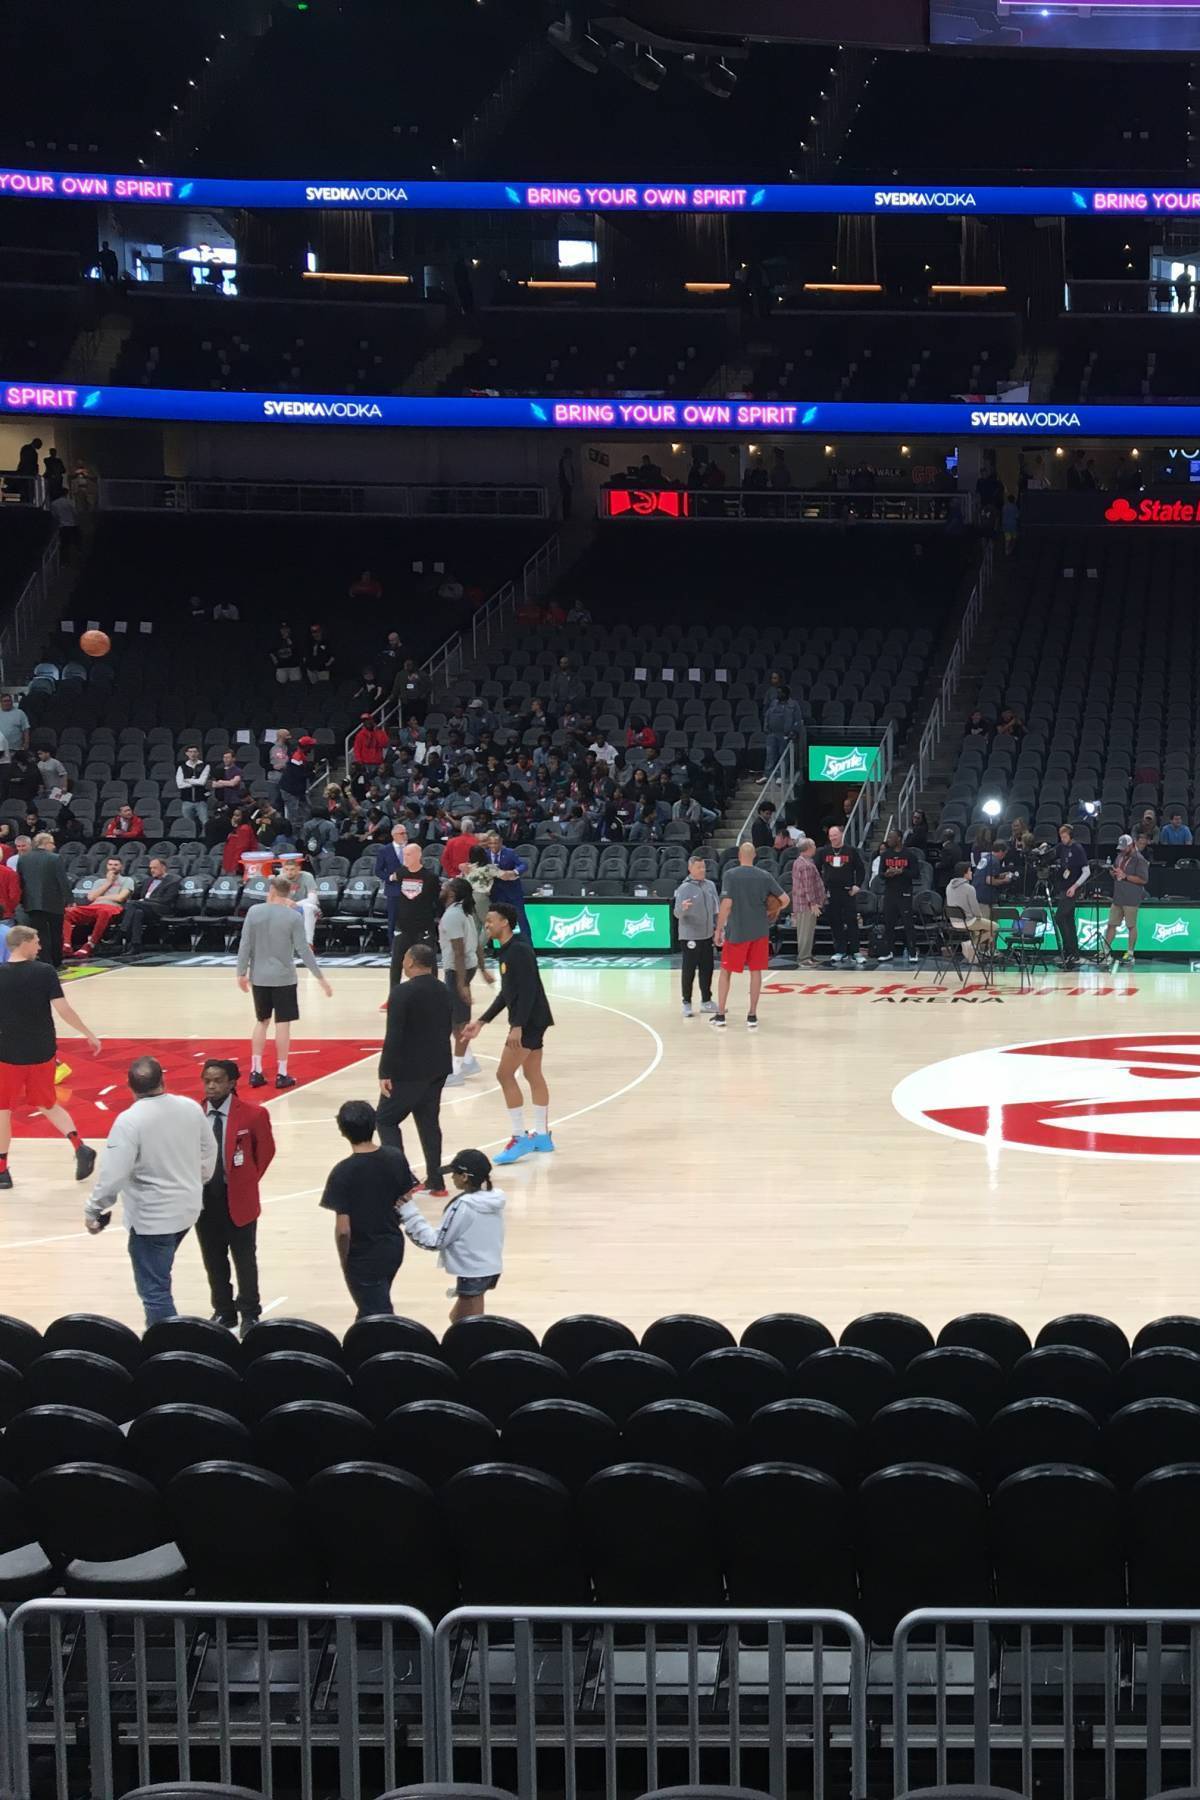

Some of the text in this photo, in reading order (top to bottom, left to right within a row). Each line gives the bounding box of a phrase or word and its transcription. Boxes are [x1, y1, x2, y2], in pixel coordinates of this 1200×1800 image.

[0, 174, 173, 197] YOUR OWN SPIRIT
[528, 188, 746, 205] BRING YOUR OWN SPIRIT
[1094, 193, 1147, 210] BRING
[6, 386, 76, 408] SPIRIT
[555, 404, 796, 424] BRING YOUR OWN SPIRIT
[1138, 499, 1194, 522] State
[825, 752, 864, 777] Sprite
[551, 911, 595, 943] Sprite
[625, 916, 652, 936] Sprite
[1156, 921, 1187, 939] Sprite
[760, 983, 950, 996] State
[871, 996, 1005, 1004] ARENA
